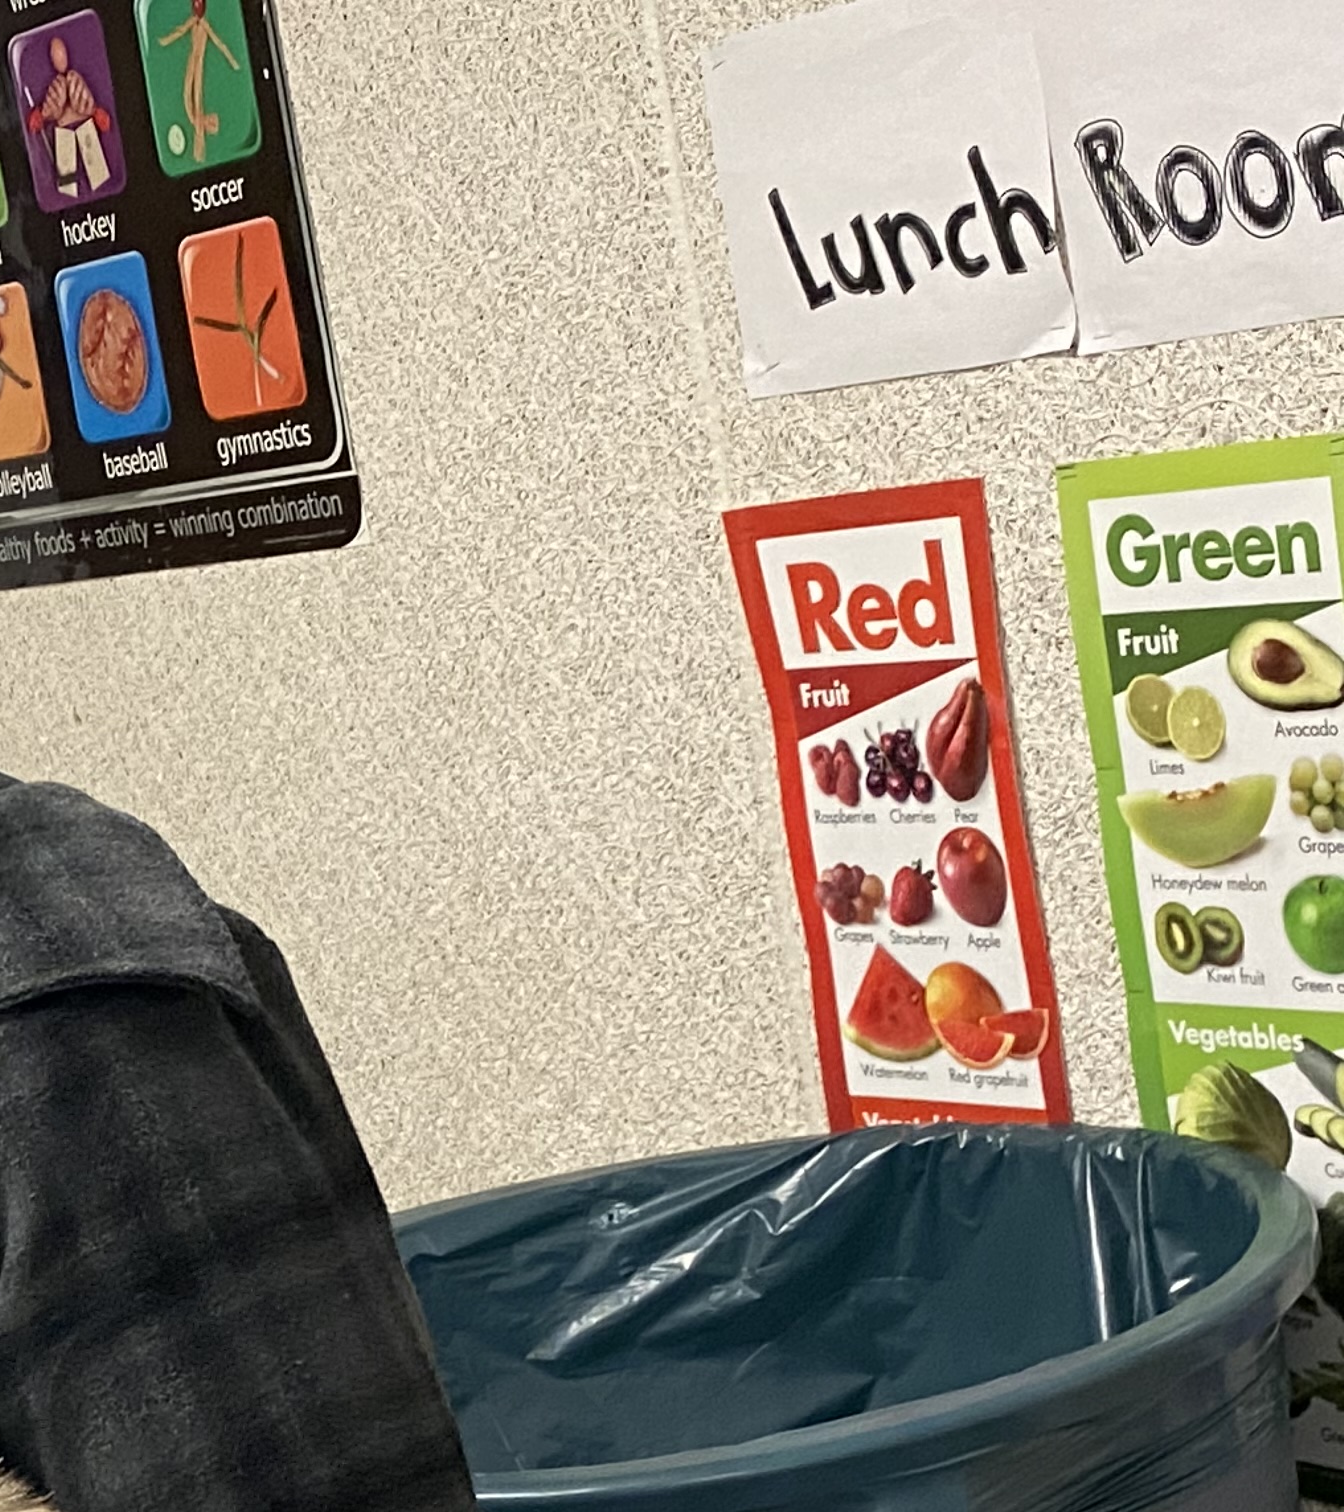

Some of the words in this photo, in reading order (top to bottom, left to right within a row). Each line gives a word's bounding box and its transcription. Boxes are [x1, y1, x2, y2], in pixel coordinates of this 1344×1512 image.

[191, 177, 244, 211] soccer
[62, 213, 116, 247] hockey
[768, 145, 1056, 310] Lunch
[217, 420, 312, 465] gymnastics
[103, 442, 168, 479] baseball
[33, 530, 75, 557] foods
[80, 534, 92, 549] +
[95, 520, 149, 549] activity
[154, 521, 167, 536] =
[168, 508, 235, 538] winning
[237, 492, 344, 529] combination
[1106, 513, 1322, 588] Green
[785, 538, 955, 654] Red
[1117, 624, 1180, 658] Fruit
[799, 680, 850, 708] Fruit
[1274, 717, 1339, 738] Avocado
[1148, 759, 1185, 775] Limes
[813, 808, 876, 828] Raspberries
[889, 808, 937, 824] Cherries
[954, 809, 979, 824] Pear
[1151, 873, 1222, 895] Honeydew
[1226, 876, 1267, 892] melon
[834, 926, 874, 946] Grapes
[889, 929, 950, 950] Strawberry
[967, 932, 1001, 952] Apple
[1206, 968, 1236, 984] Kiwi
[1239, 967, 1266, 986] fruit
[1292, 976, 1333, 994] Green
[1167, 1019, 1305, 1053] Vegetables
[860, 1063, 929, 1082] Watermelon
[948, 1067, 971, 1085] Red
[973, 1070, 1029, 1090] grapefruit
